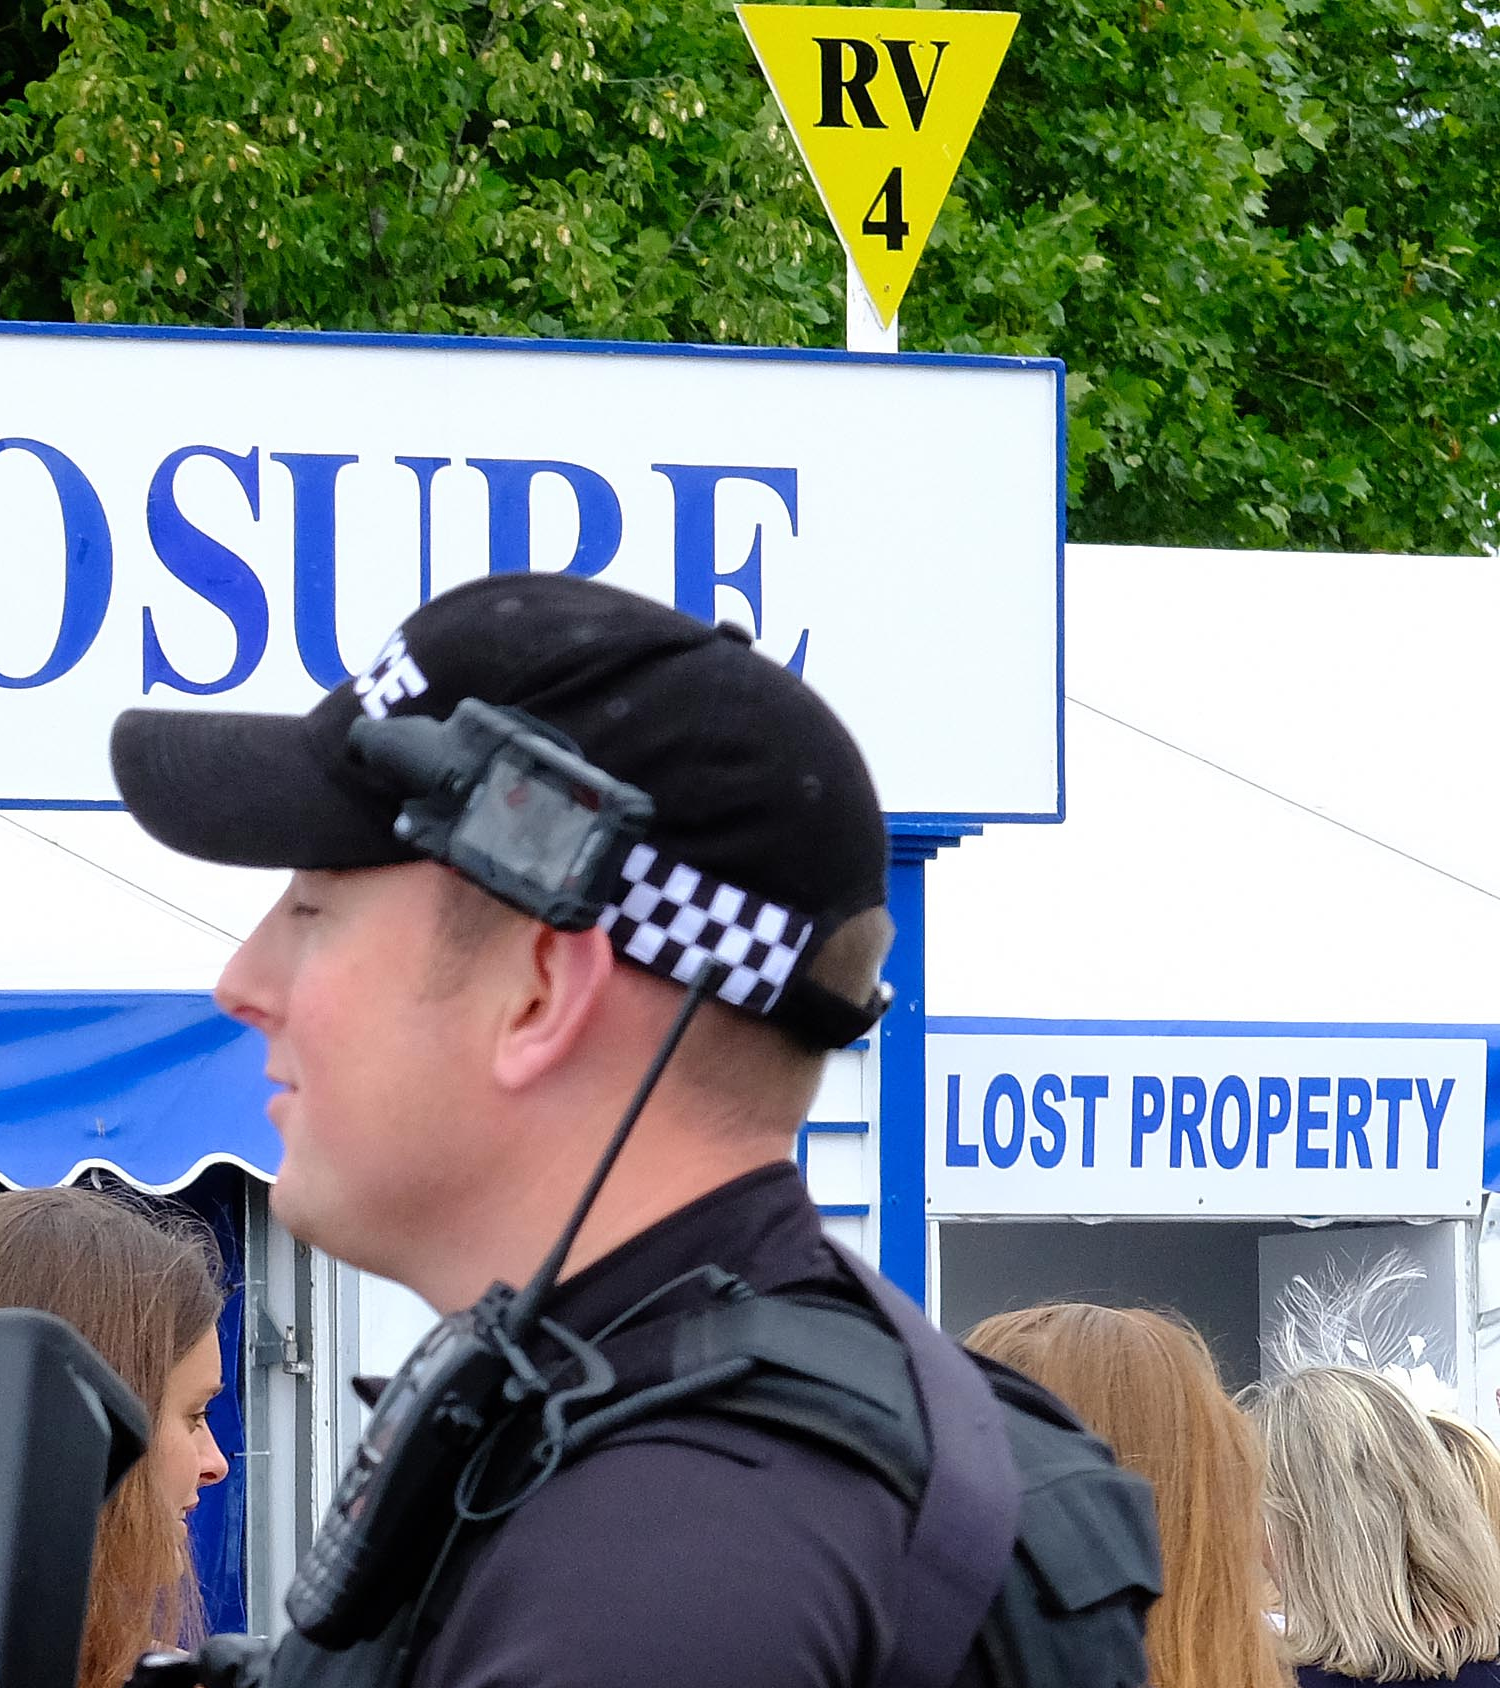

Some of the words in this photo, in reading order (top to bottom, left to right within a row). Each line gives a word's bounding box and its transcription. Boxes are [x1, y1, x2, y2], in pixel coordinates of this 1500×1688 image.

[811, 37, 950, 132] RV
[862, 166, 910, 251] 4
[945, 1072, 1110, 1169] LOST
[1130, 1074, 1456, 1171] PROPERTY
